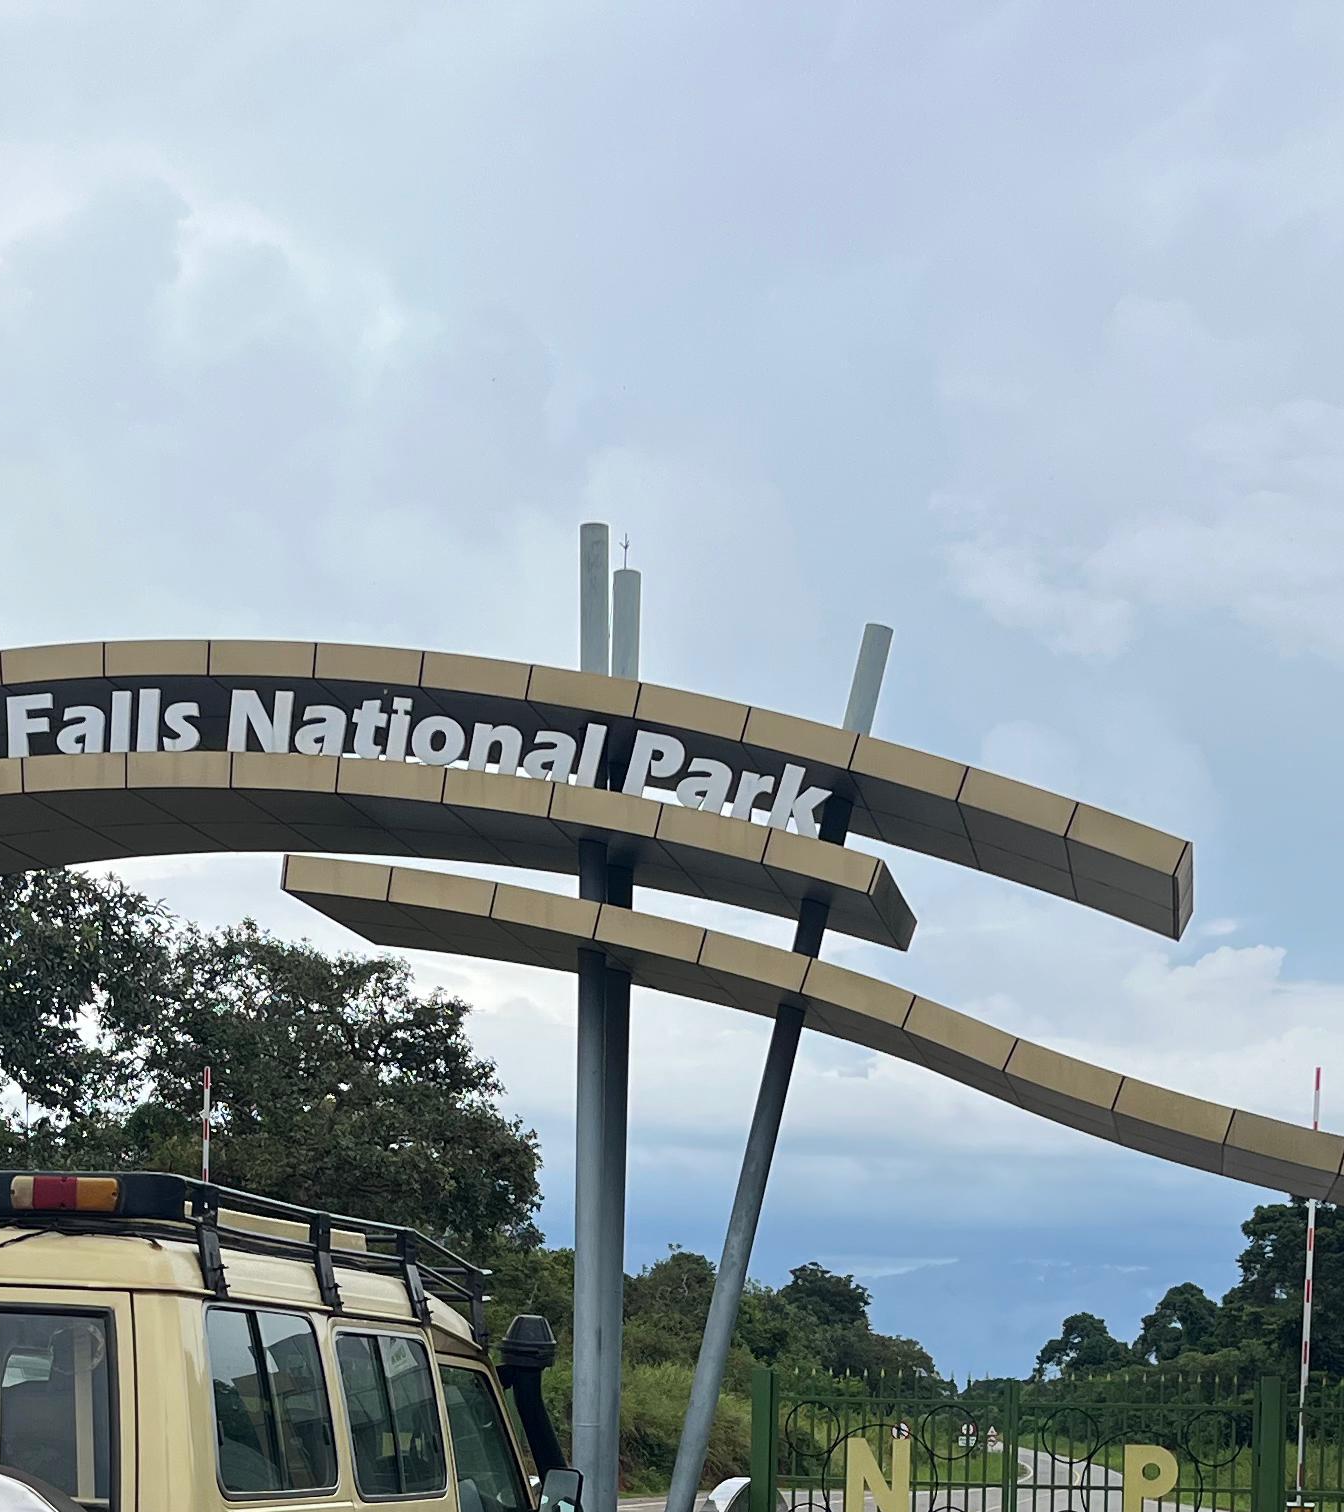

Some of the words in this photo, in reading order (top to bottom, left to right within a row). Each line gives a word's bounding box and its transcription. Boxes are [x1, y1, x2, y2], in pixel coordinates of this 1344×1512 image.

[5, 687, 200, 758] Falls
[227, 689, 608, 788] National
[621, 729, 833, 840] Park
